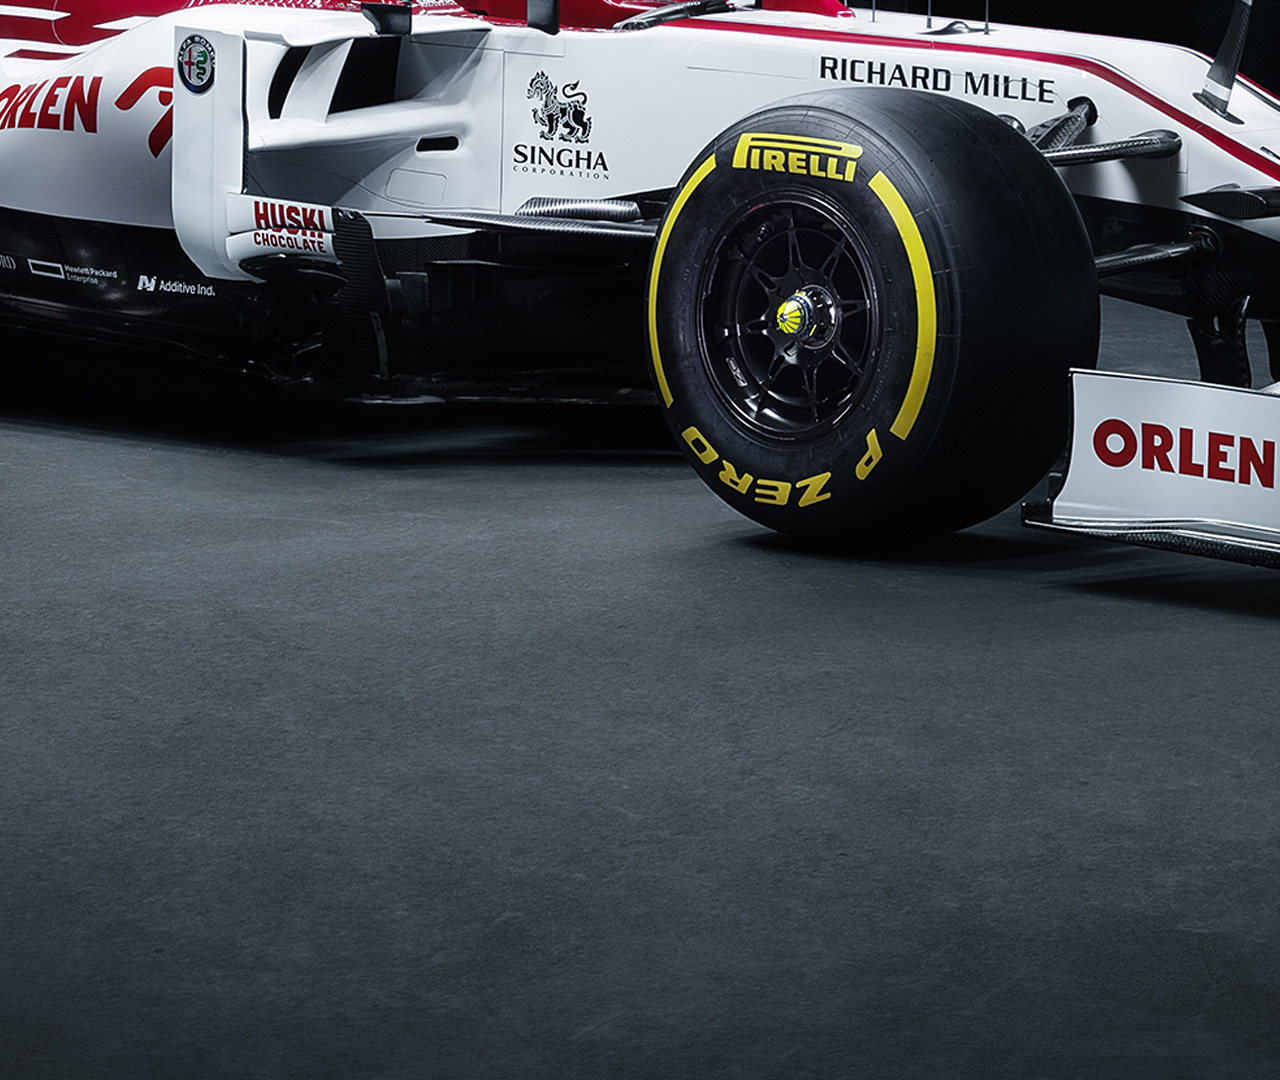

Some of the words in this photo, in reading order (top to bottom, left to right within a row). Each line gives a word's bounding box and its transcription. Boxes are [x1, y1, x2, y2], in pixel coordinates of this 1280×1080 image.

[820, 55, 952, 93] RICHARD
[963, 72, 1056, 104] MILLE
[512, 165, 610, 180] CORPORATION
[513, 144, 609, 172] SINGHA
[732, 132, 863, 183] PIRELLI
[254, 200, 327, 239] HUSKI
[253, 232, 328, 254] CHOCOLATE
[90, 268, 118, 279] Packard
[159, 280, 196, 295] Additive
[681, 425, 833, 508] ZERO
[855, 427, 884, 481] P
[1092, 418, 1277, 490] ORLEN
